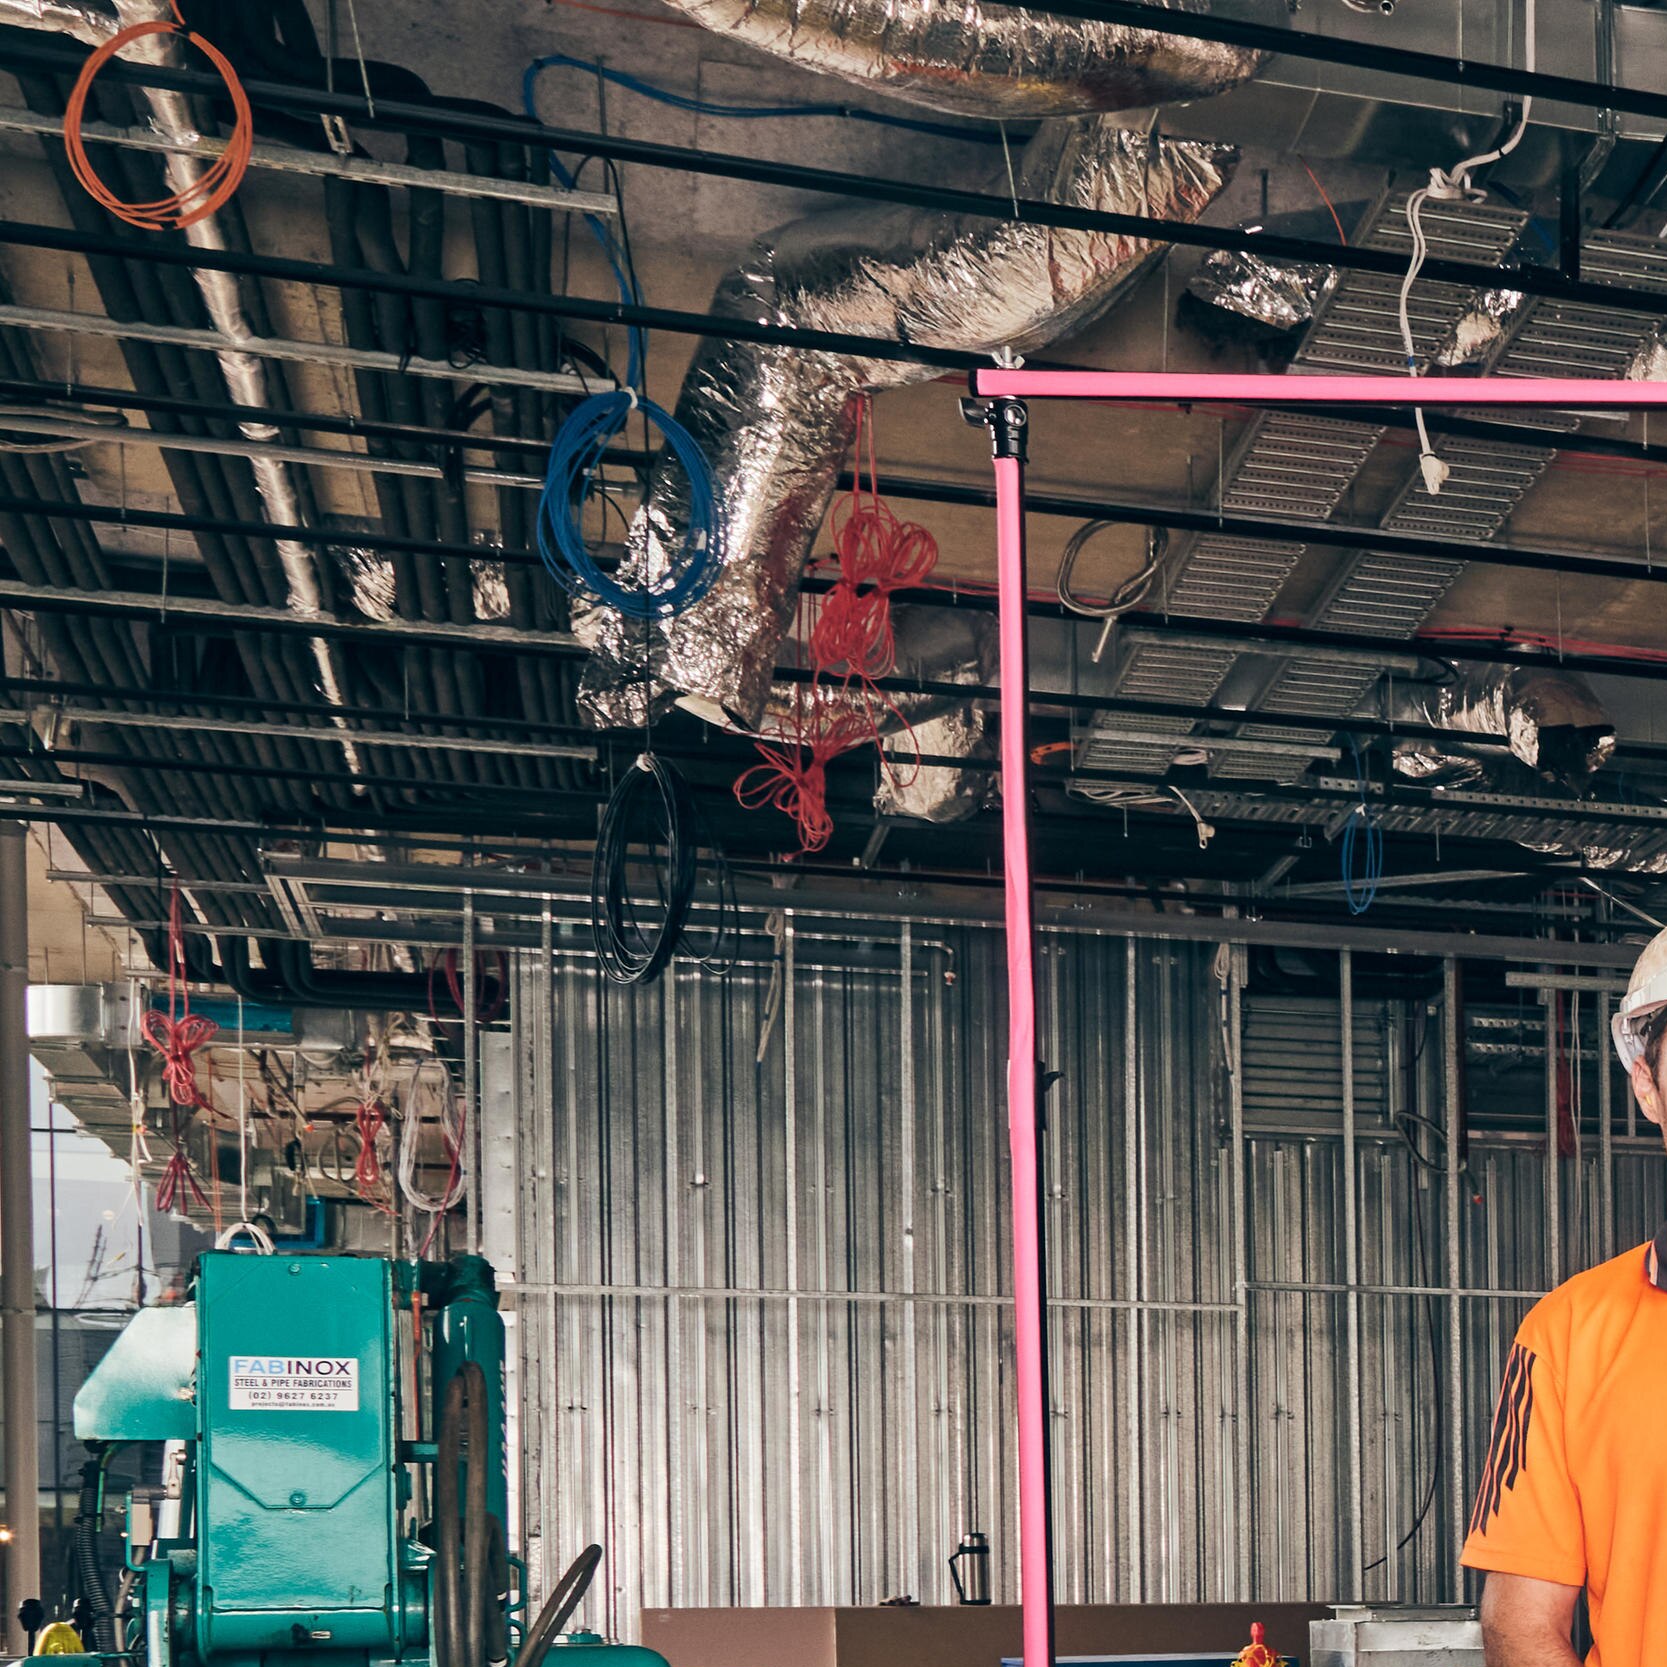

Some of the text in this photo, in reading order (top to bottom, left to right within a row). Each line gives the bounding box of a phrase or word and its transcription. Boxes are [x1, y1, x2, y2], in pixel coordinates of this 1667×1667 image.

[234, 1360, 351, 1375] FABINOX
[234, 1378, 352, 1388] STEEL & PIPE FABRICATIONS
[248, 1391, 338, 1400] (02) 9627 6237
